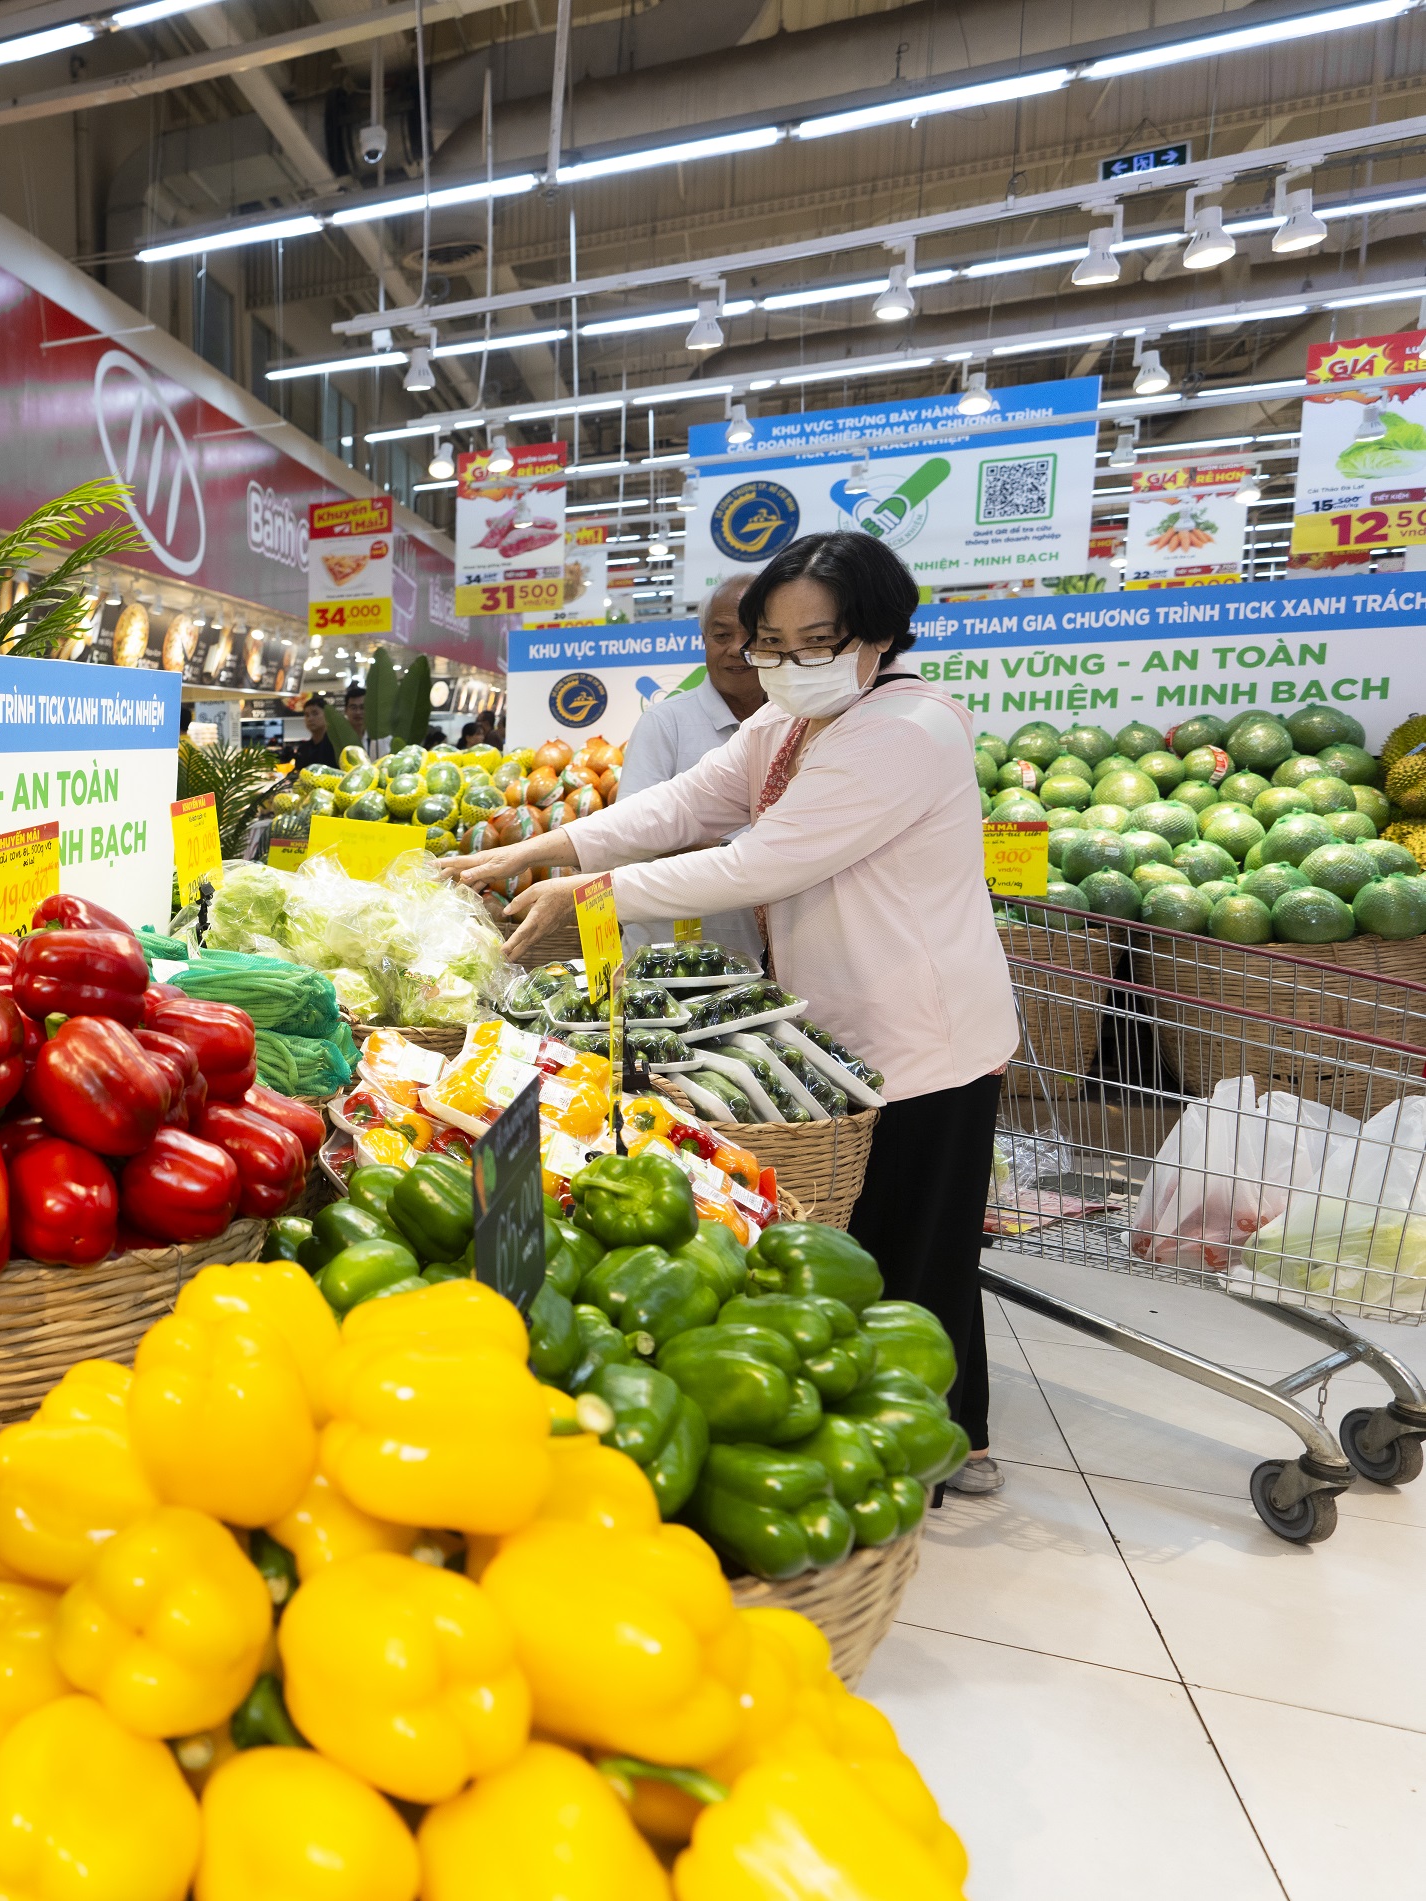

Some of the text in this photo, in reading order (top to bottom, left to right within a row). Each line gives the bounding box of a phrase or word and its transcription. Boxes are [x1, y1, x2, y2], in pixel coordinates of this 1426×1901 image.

[1327, 353, 1378, 377] GIÁ
[758, 434, 806, 450] DOANH
[864, 424, 904, 439] THAM
[908, 422, 933, 436] GIA
[934, 411, 1002, 430] CHƯƠNG
[1006, 406, 1053, 421] TRÌNH
[772, 424, 801, 437] KHU
[804, 419, 834, 435] VỰC
[836, 412, 886, 430] TRƯNG
[890, 408, 919, 424] BÀY
[1146, 470, 1180, 486] GIÁ
[914, 551, 1059, 573] NHIỆM MINH BẠCH
[909, 589, 1426, 641] GHIỆP THAM GIA CHƯƠNG TRÌNH TICK XANH TRÁCH
[529, 642, 560, 660] KHU
[564, 640, 596, 662] VỰC
[599, 636, 652, 656] TRƯNG
[655, 632, 688, 653] BÀY
[920, 651, 989, 682] BỀN
[1001, 651, 1105, 679] VỮNG
[1141, 648, 1199, 673] AN
[1212, 637, 1327, 669] TOÀN
[38, 694, 65, 725] TICK
[67, 696, 99, 725] XANH
[101, 691, 134, 725] TRÁCH
[135, 694, 165, 733] NHIỆM
[1002, 682, 1118, 717] NHIỆM
[1156, 682, 1257, 707] MINH
[11, 776, 49, 812] AN
[56, 758, 119, 807] TOÀN
[997, 822, 1018, 831] MÃI
[90, 820, 147, 869] BẠCH
